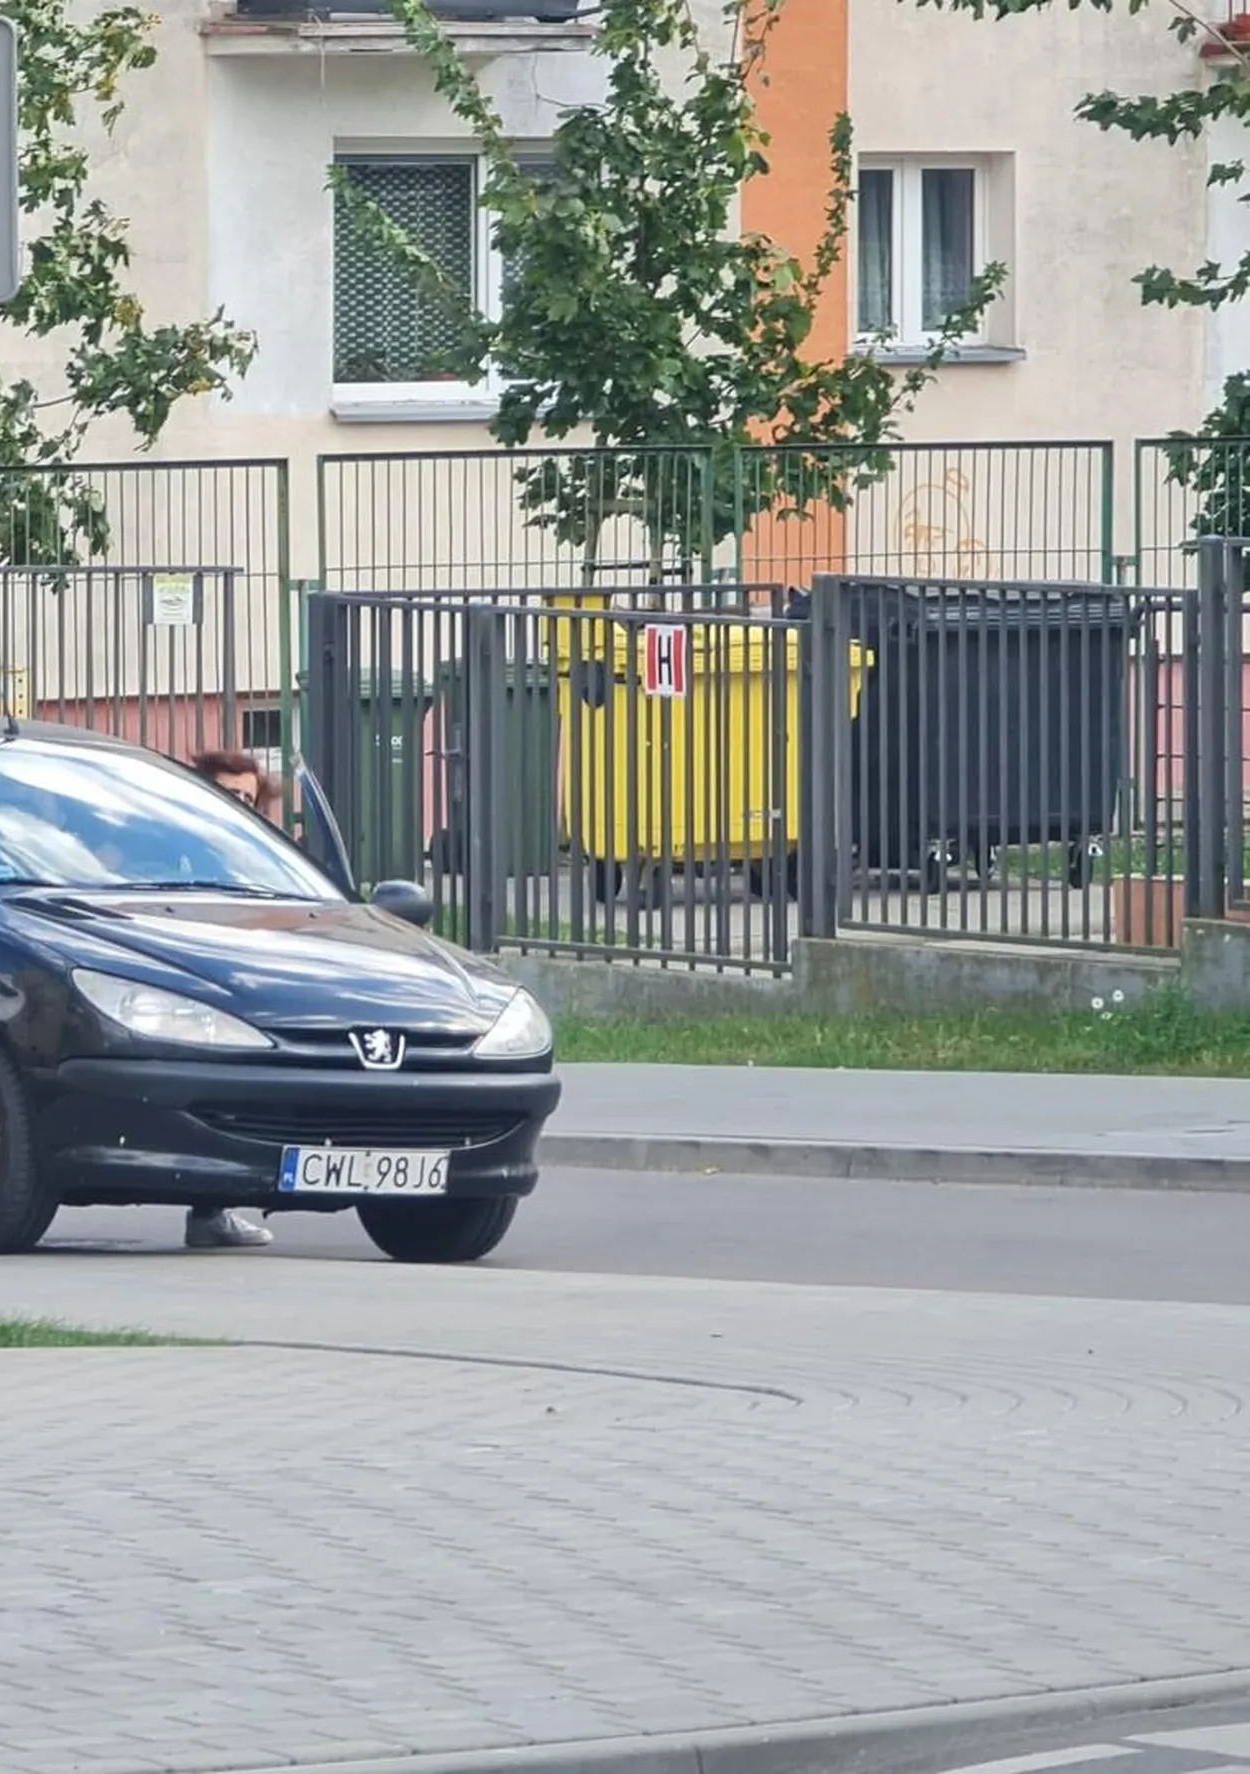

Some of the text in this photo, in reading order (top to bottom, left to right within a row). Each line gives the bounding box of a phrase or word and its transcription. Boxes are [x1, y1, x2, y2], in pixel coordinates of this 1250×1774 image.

[658, 635, 672, 685] H
[302, 1154, 448, 1188] CWL 98J6
